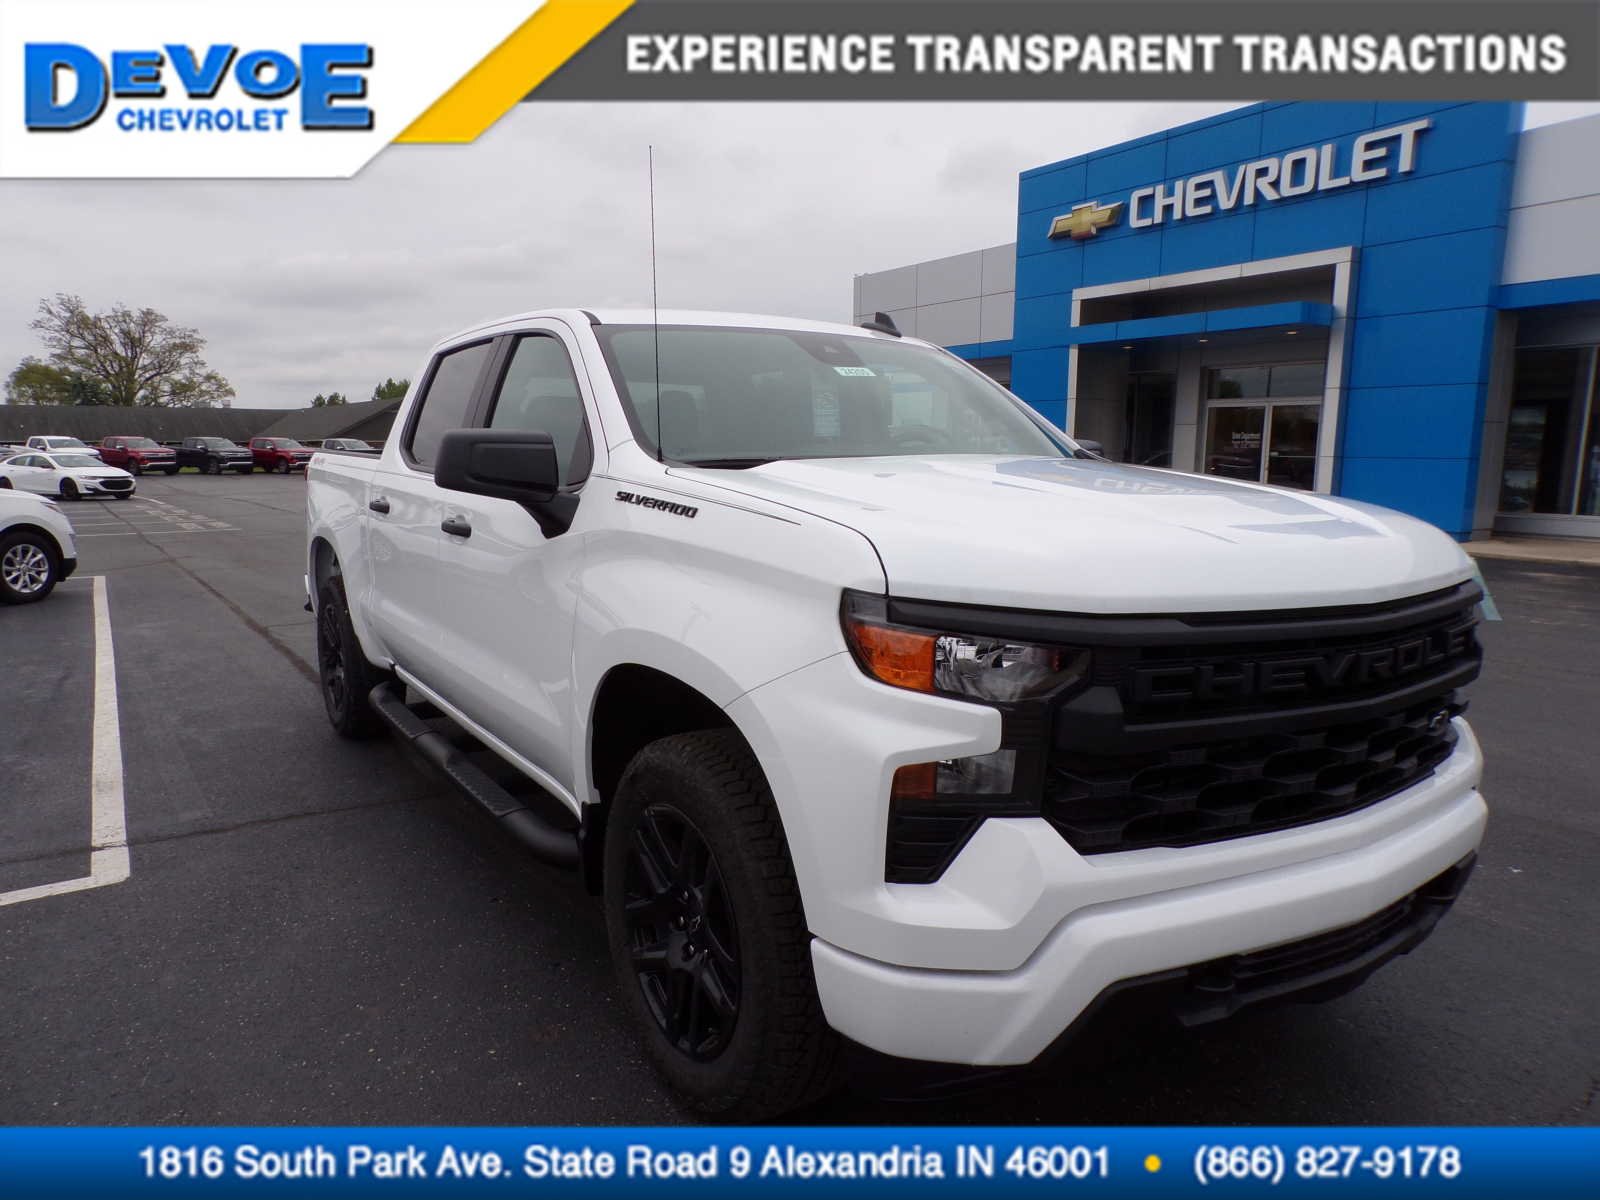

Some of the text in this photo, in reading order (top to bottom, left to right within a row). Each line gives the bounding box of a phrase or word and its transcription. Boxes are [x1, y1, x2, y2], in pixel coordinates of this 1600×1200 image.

[1128, 117, 1431, 229] CHEVROLET
[615, 491, 698, 519] SILVERADO
[1131, 618, 1480, 702] CHEVROLE
